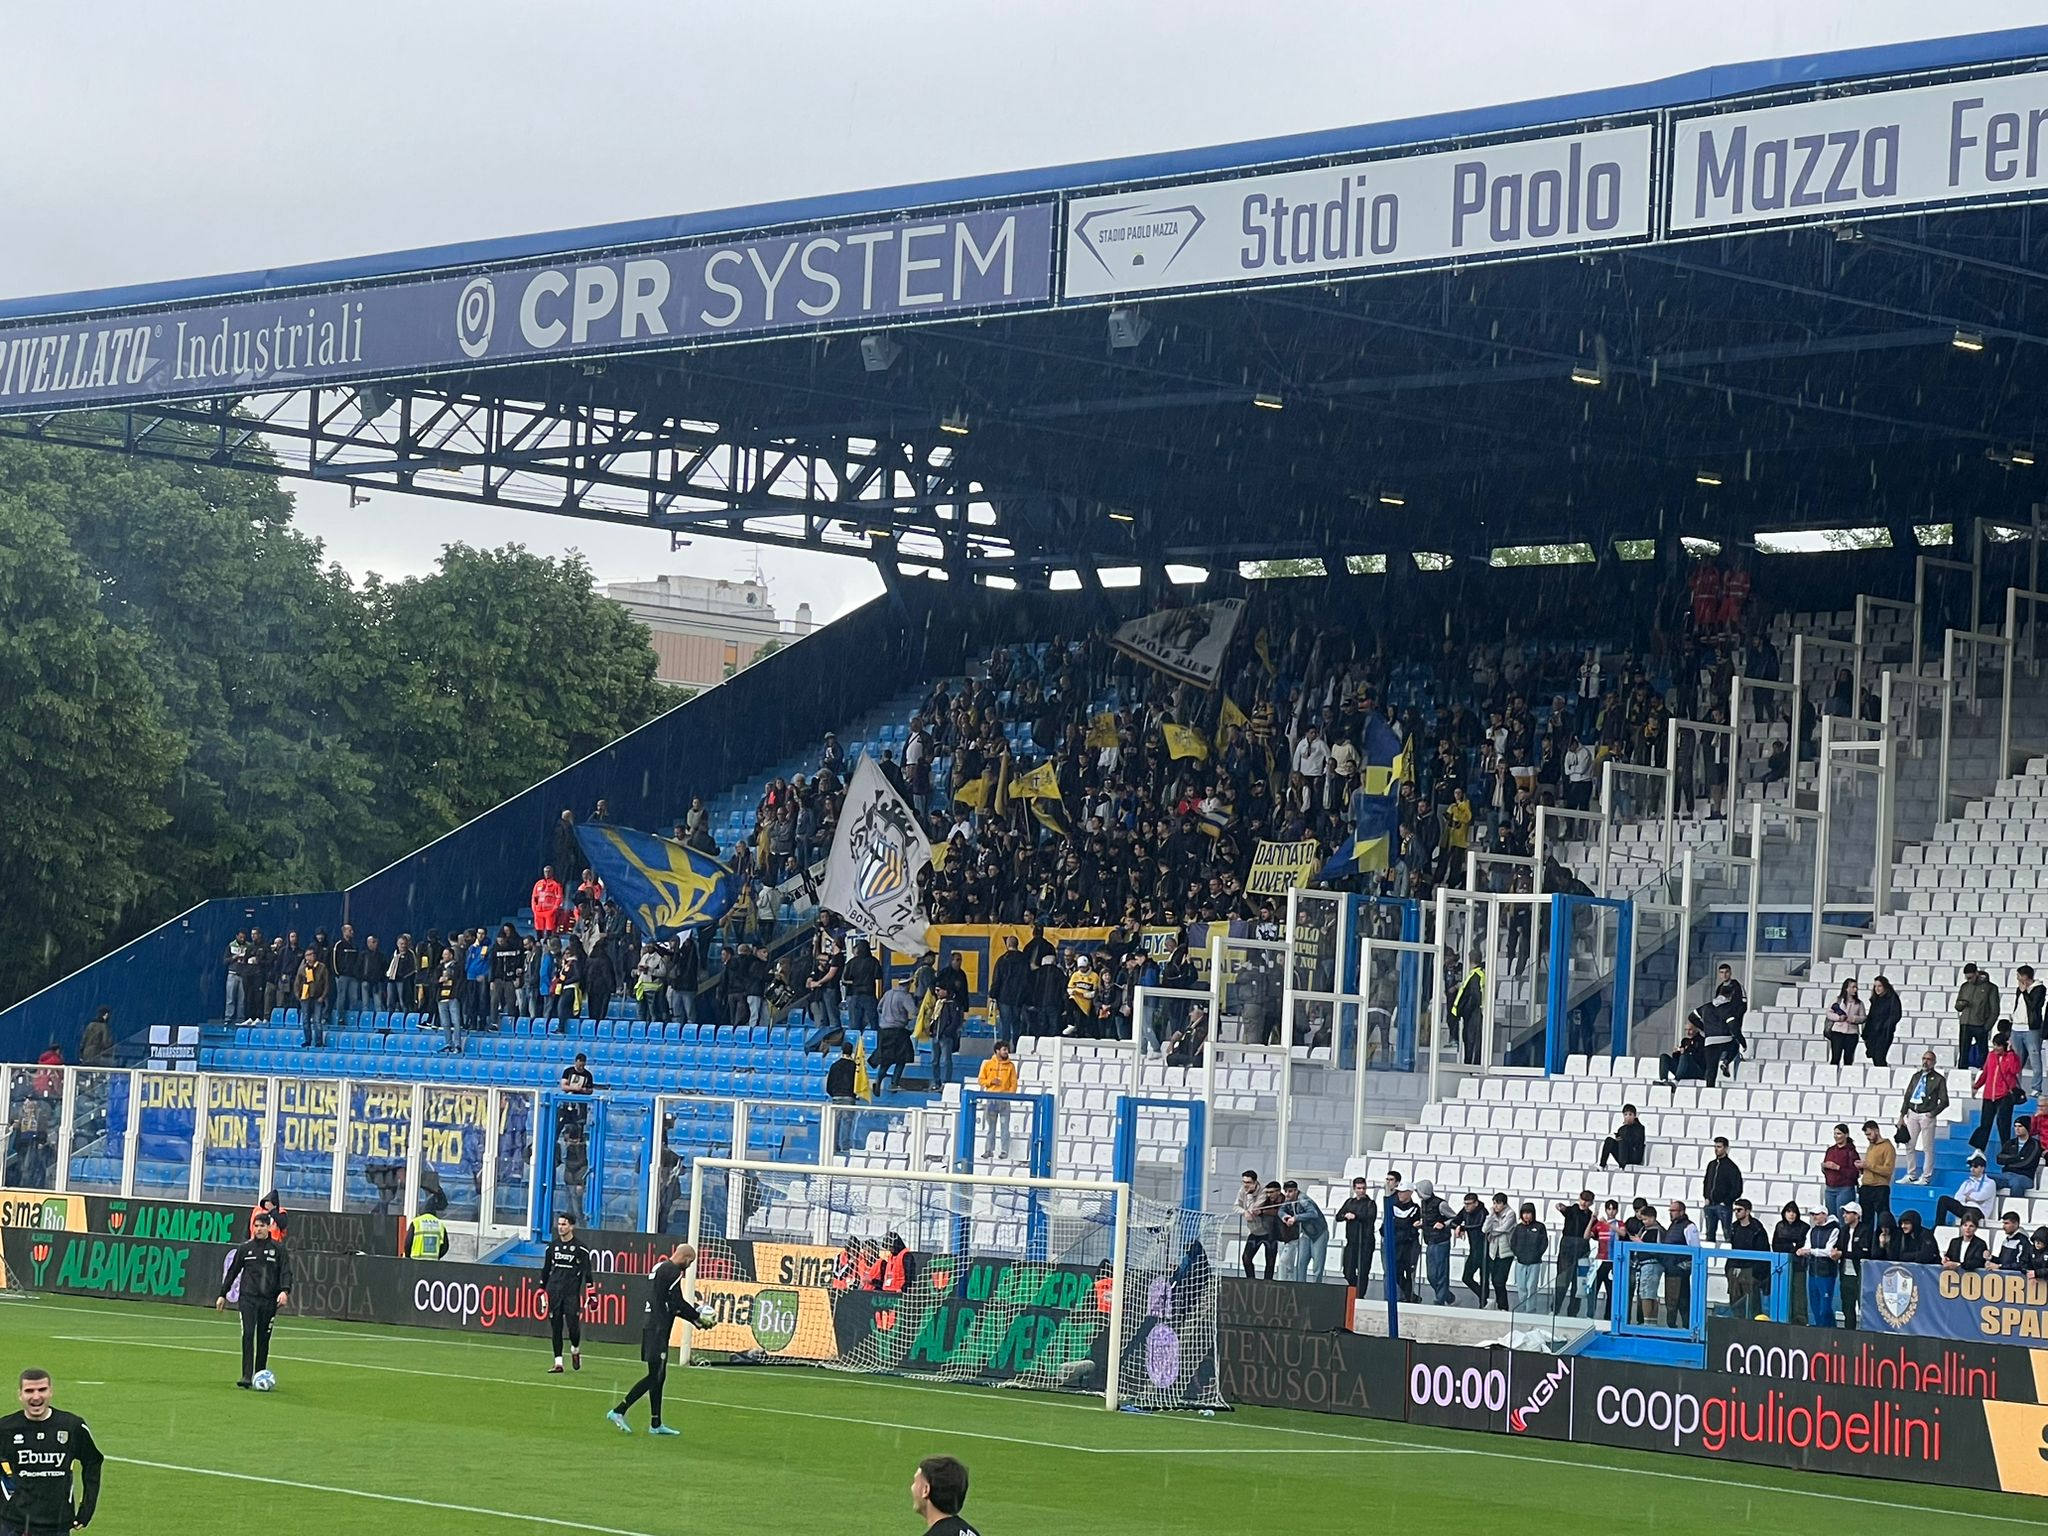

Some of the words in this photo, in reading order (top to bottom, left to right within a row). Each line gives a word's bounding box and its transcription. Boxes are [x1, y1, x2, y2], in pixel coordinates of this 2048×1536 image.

[1695, 124, 1901, 220] Mazza
[1240, 174, 1400, 270] Stadio
[1451, 142, 1621, 248] Paolo
[1098, 229, 1126, 243] STADIO
[1126, 225, 1151, 240] PAOLO
[1152, 221, 1178, 236] MAZZA
[519, 258, 671, 348] CPR
[700, 216, 1016, 327] SYSTEM
[173, 302, 364, 380] Industriali
[849, 909, 877, 932] BOYS
[280, 1079, 356, 1115] CUOR
[44, 1206, 65, 1231] Bio
[132, 1205, 235, 1244] ALBAVERDE
[300, 1214, 366, 1245] TENUTA
[56, 1238, 191, 1298] ALBAVERDE
[1217, 1281, 1299, 1317] ENUTA
[1938, 1269, 2048, 1307] COORD
[757, 1299, 795, 1335] Bio
[1219, 1361, 1371, 1409] ARUSOLA
[1410, 1362, 1506, 1412] 00:00
[1518, 1358, 1571, 1426] NGM
[1596, 1384, 1941, 1463] coopgiuliobellini
[17, 1449, 66, 1468] Ebury
